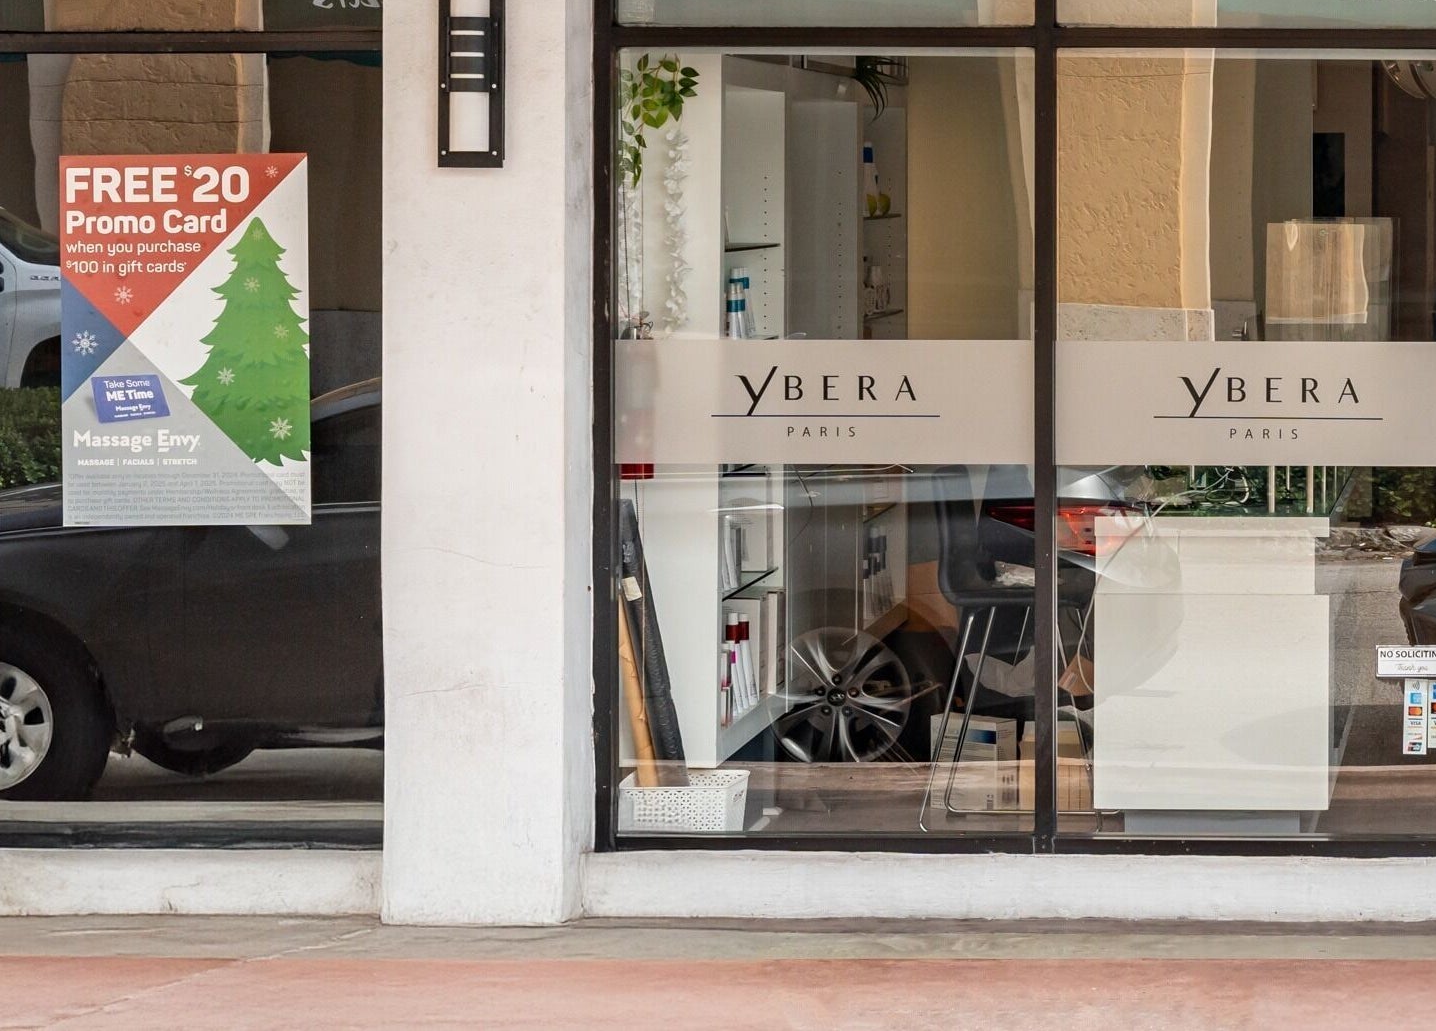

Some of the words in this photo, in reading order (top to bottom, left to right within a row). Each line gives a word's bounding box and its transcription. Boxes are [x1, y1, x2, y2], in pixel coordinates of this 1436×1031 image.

[66, 166, 178, 203] FREE
[183, 165, 250, 203] $20
[66, 210, 156, 234] Promo
[163, 208, 227, 234] Card
[66, 240, 103, 254] when
[107, 243, 133, 257] you
[137, 240, 201, 256] purchase
[66, 259, 99, 273] $100
[103, 260, 115, 273] in
[118, 259, 143, 277] gift
[103, 379, 125, 389] Take
[126, 379, 151, 388] Some
[734, 365, 917, 417] YBERA
[1177, 367, 1359, 418] YBERA
[106, 389, 126, 401] ME
[126, 389, 154, 401] Time
[787, 426, 857, 437] PARIS
[1229, 428, 1299, 439] PARIS
[73, 429, 153, 453] Massage
[78, 458, 115, 466] MASSAGE
[122, 457, 154, 466] FACIALS
[1380, 650, 1394, 658] NO
